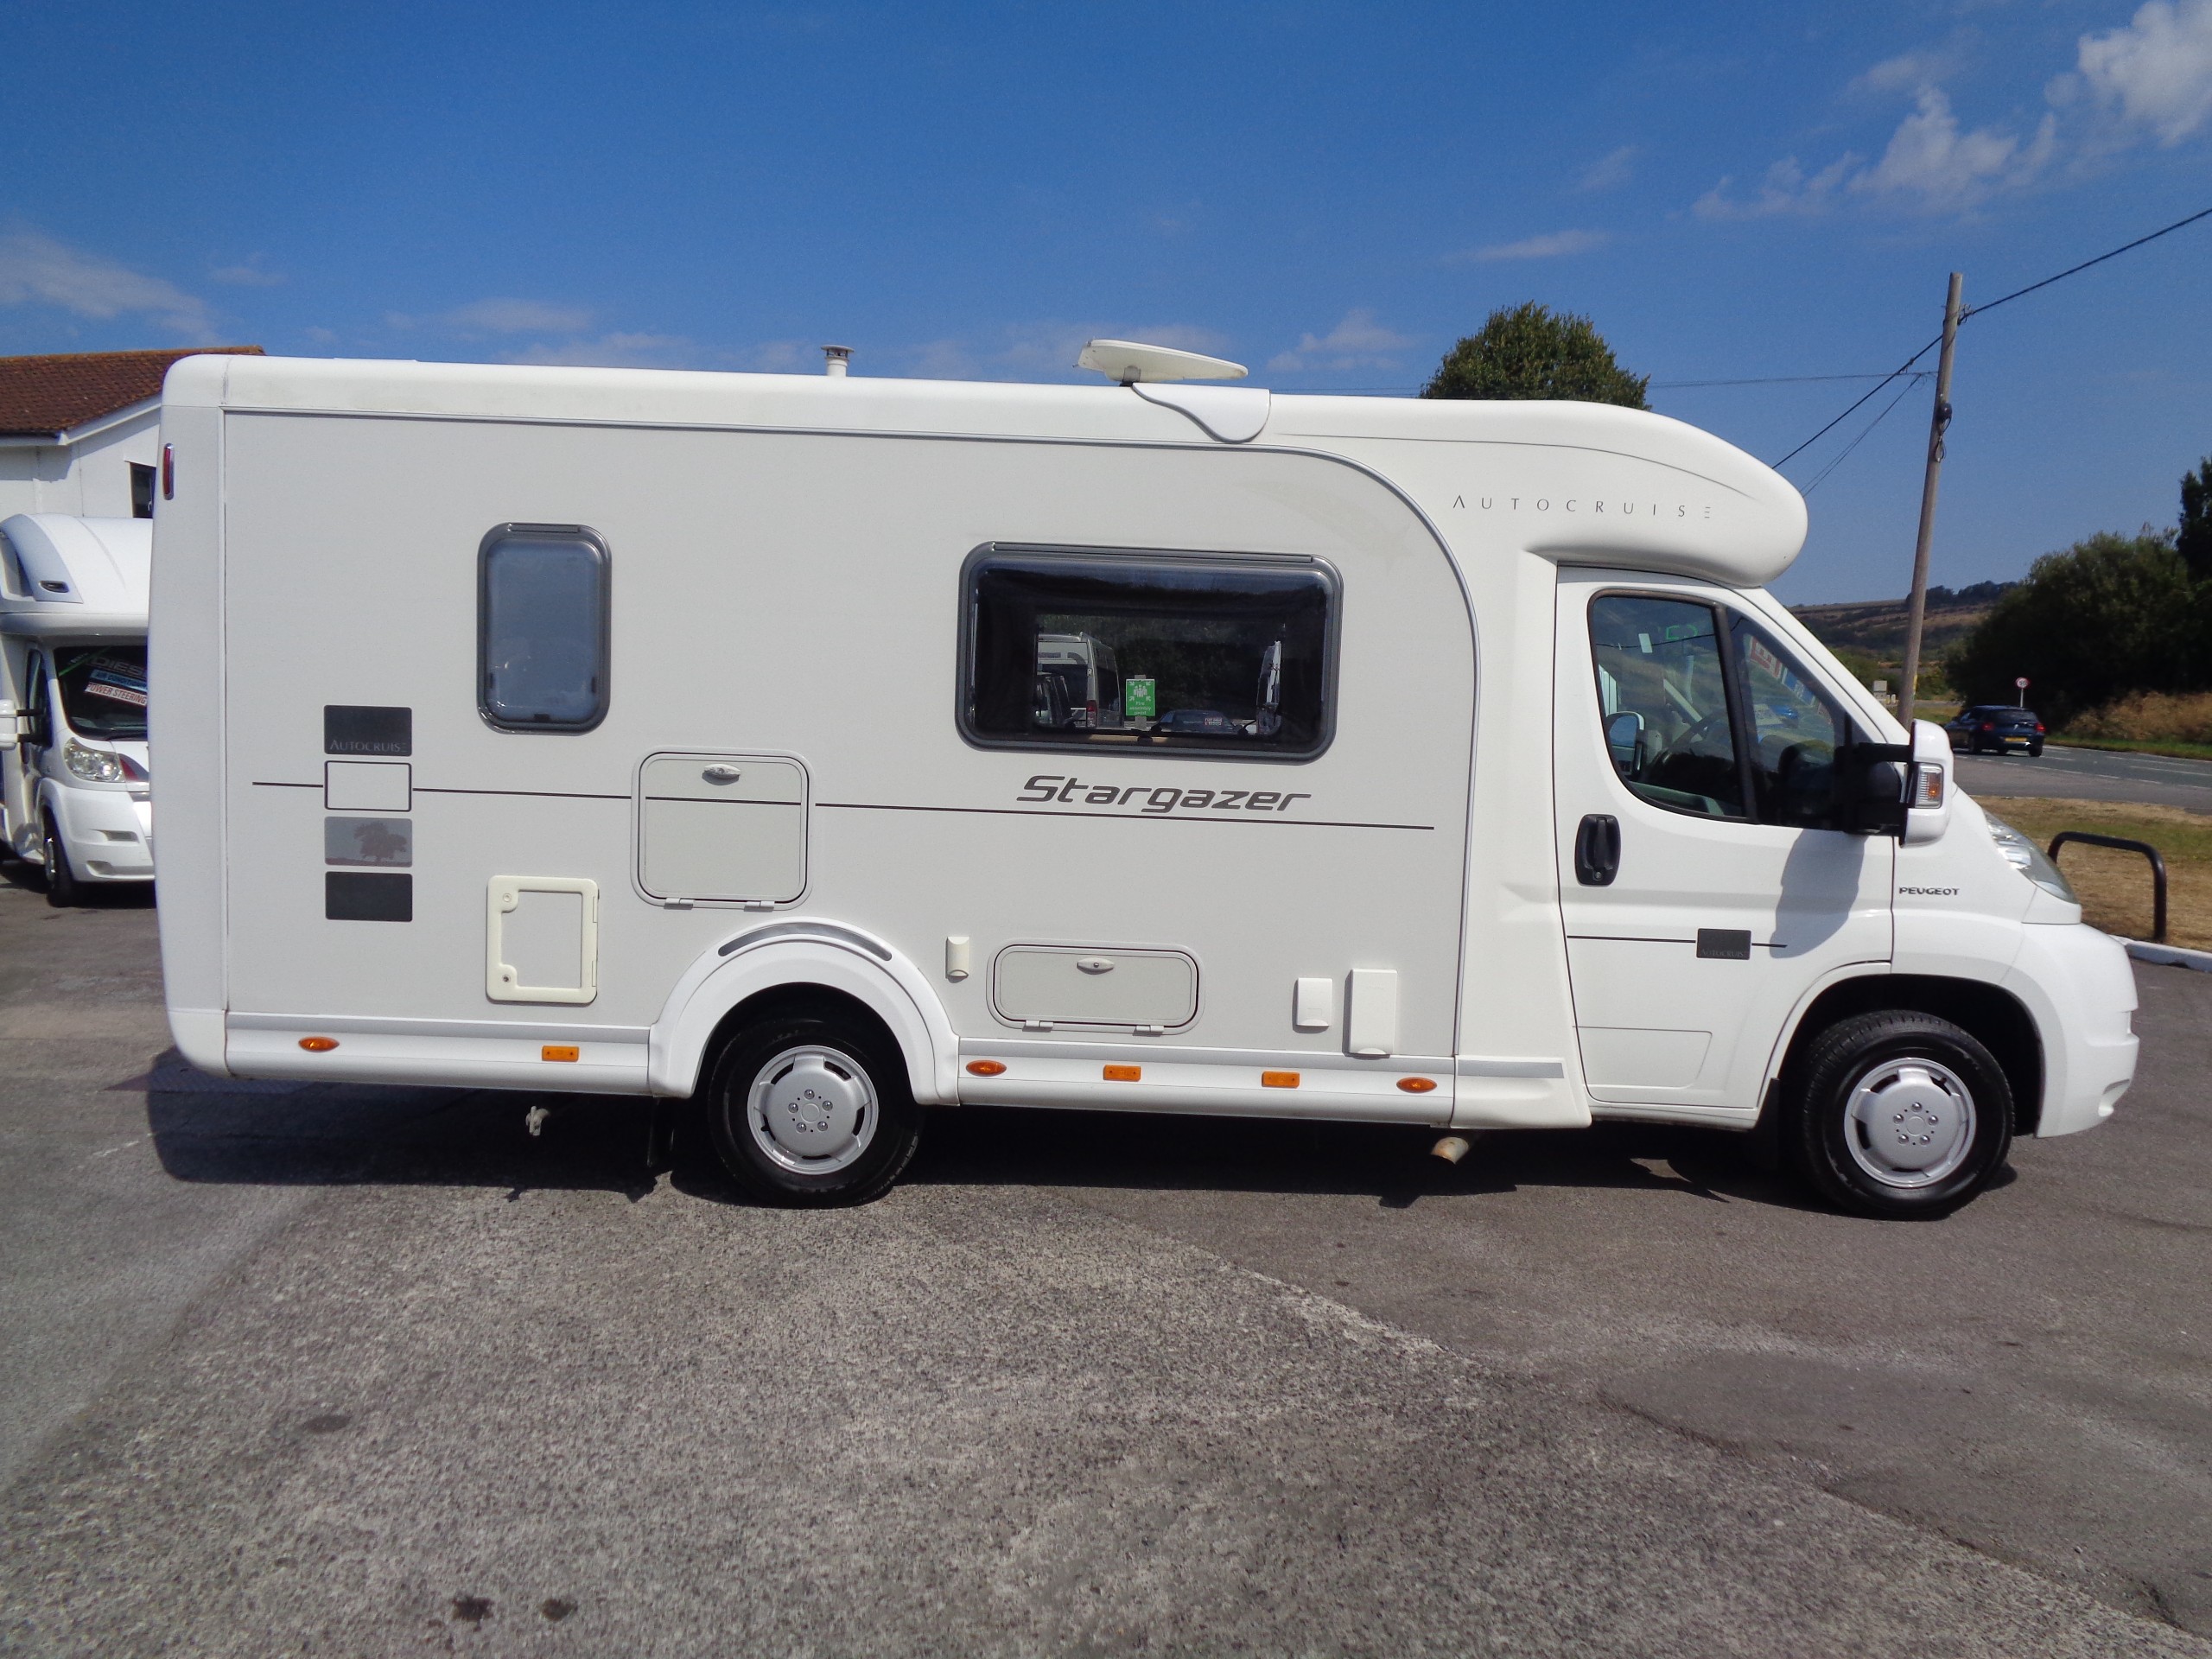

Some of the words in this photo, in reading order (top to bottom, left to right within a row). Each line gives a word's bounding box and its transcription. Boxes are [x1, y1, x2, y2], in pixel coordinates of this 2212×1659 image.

[1452, 494, 1712, 518] AUTOCRUISE
[90, 657, 145, 676] DIES
[87, 683, 112, 695] POWER
[113, 689, 147, 703] STEERING
[1016, 775, 1312, 813] Stargazer
[1898, 887, 1960, 895] PEUGEOT
[1700, 949, 1748, 958] AUTOCRUIS
